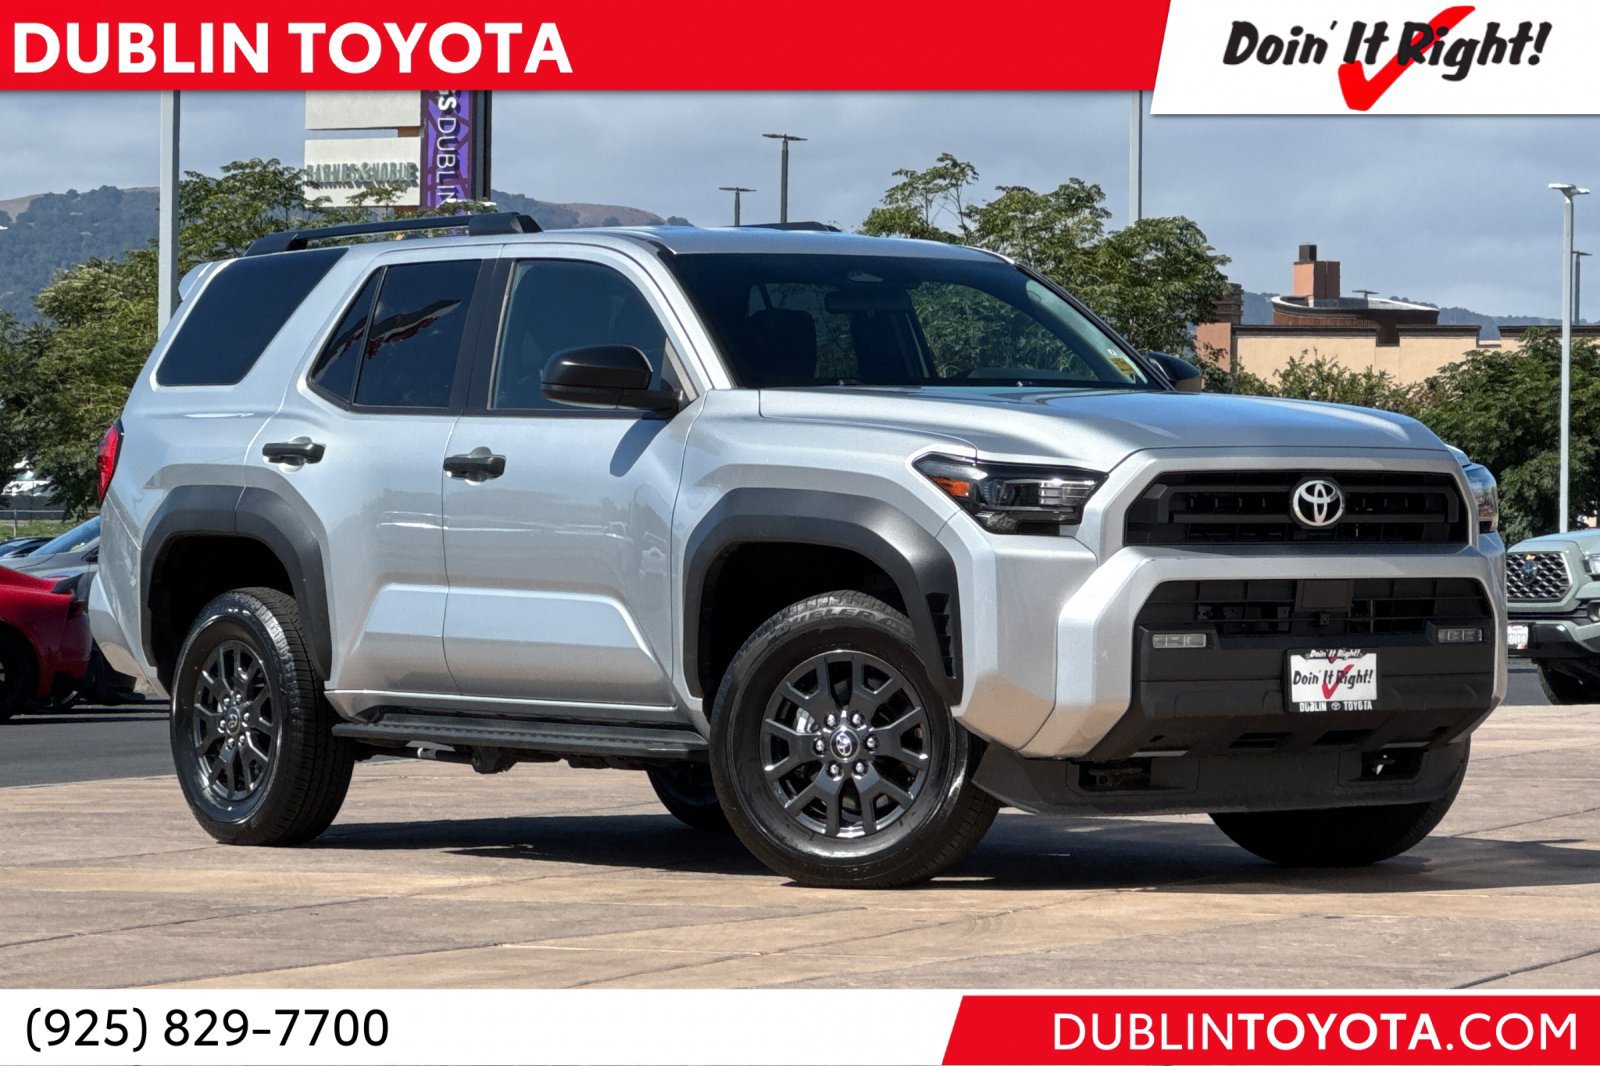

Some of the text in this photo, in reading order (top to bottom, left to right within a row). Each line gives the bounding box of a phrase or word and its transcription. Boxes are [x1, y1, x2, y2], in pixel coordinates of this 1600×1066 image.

[1292, 669, 1374, 689] Doin' It Right!
[1299, 700, 1373, 712] DUBLIN TOYOTA
